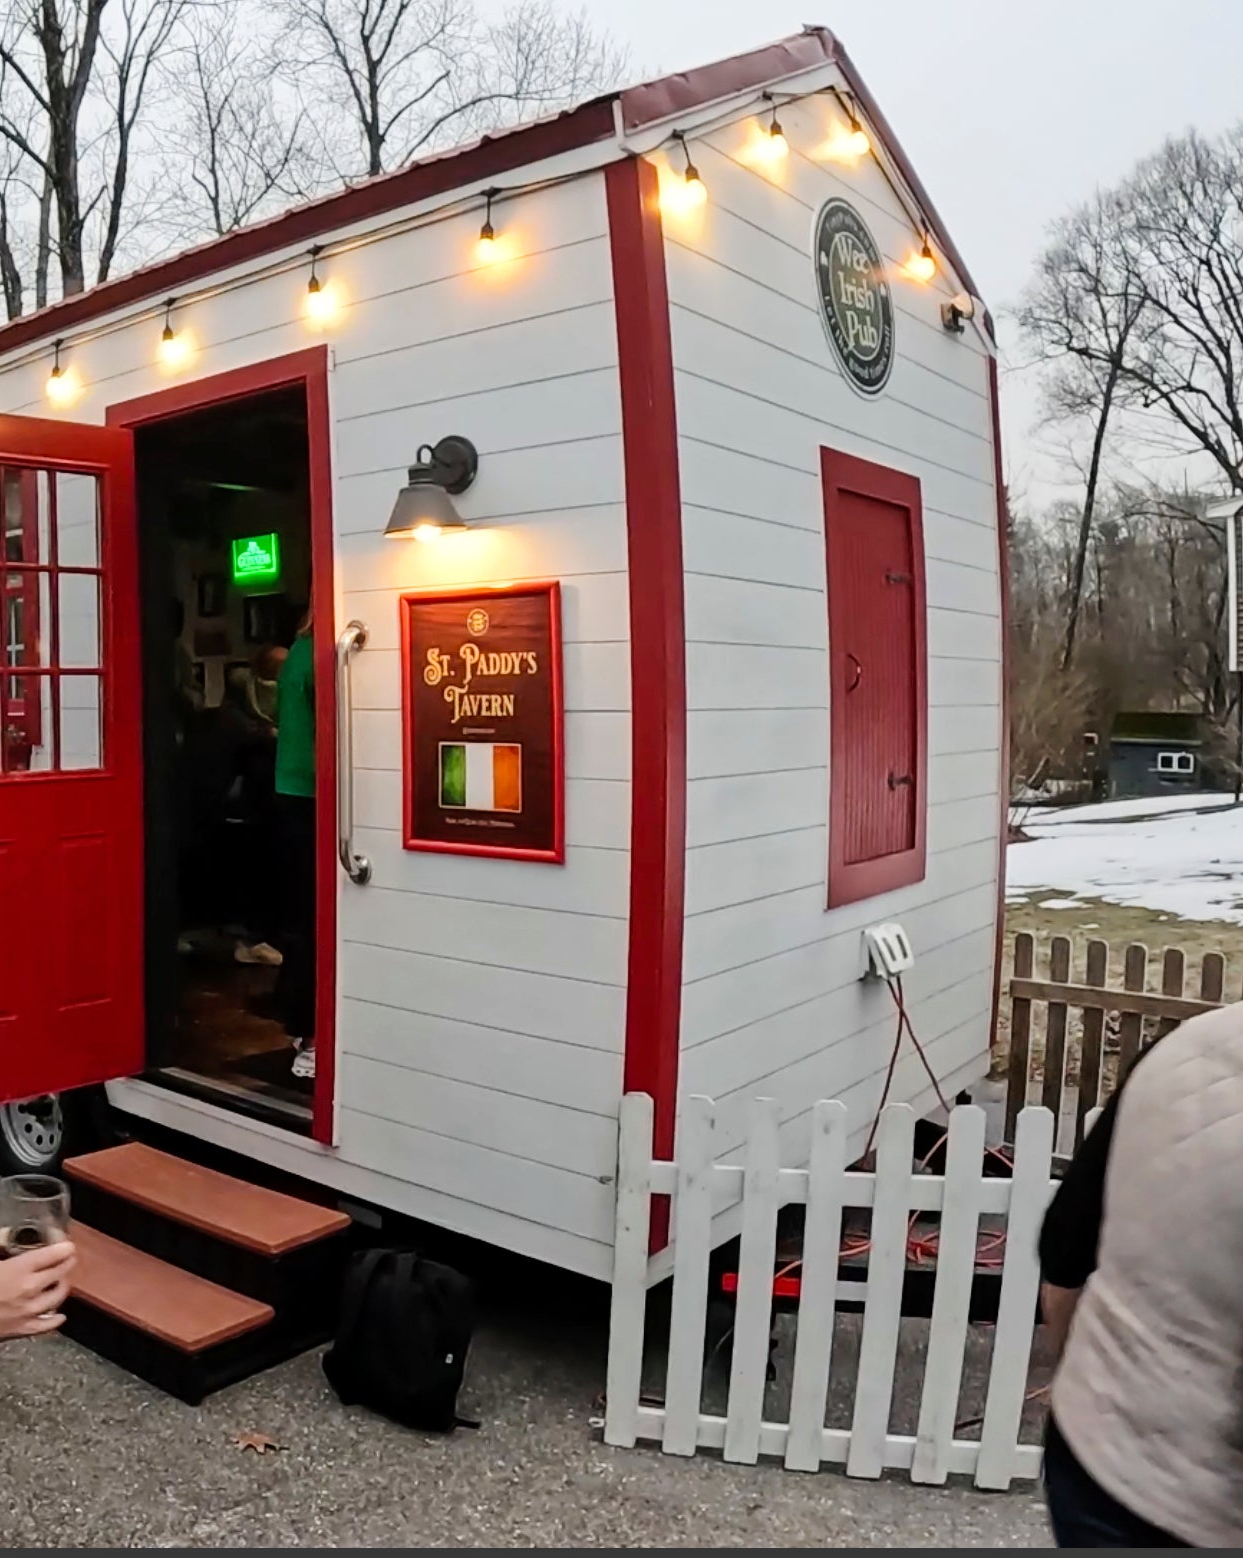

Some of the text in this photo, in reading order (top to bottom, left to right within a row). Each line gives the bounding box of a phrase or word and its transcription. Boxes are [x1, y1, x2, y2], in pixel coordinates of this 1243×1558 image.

[836, 235, 871, 273] Wee
[837, 271, 875, 314] Irish
[845, 310, 878, 351] Pub
